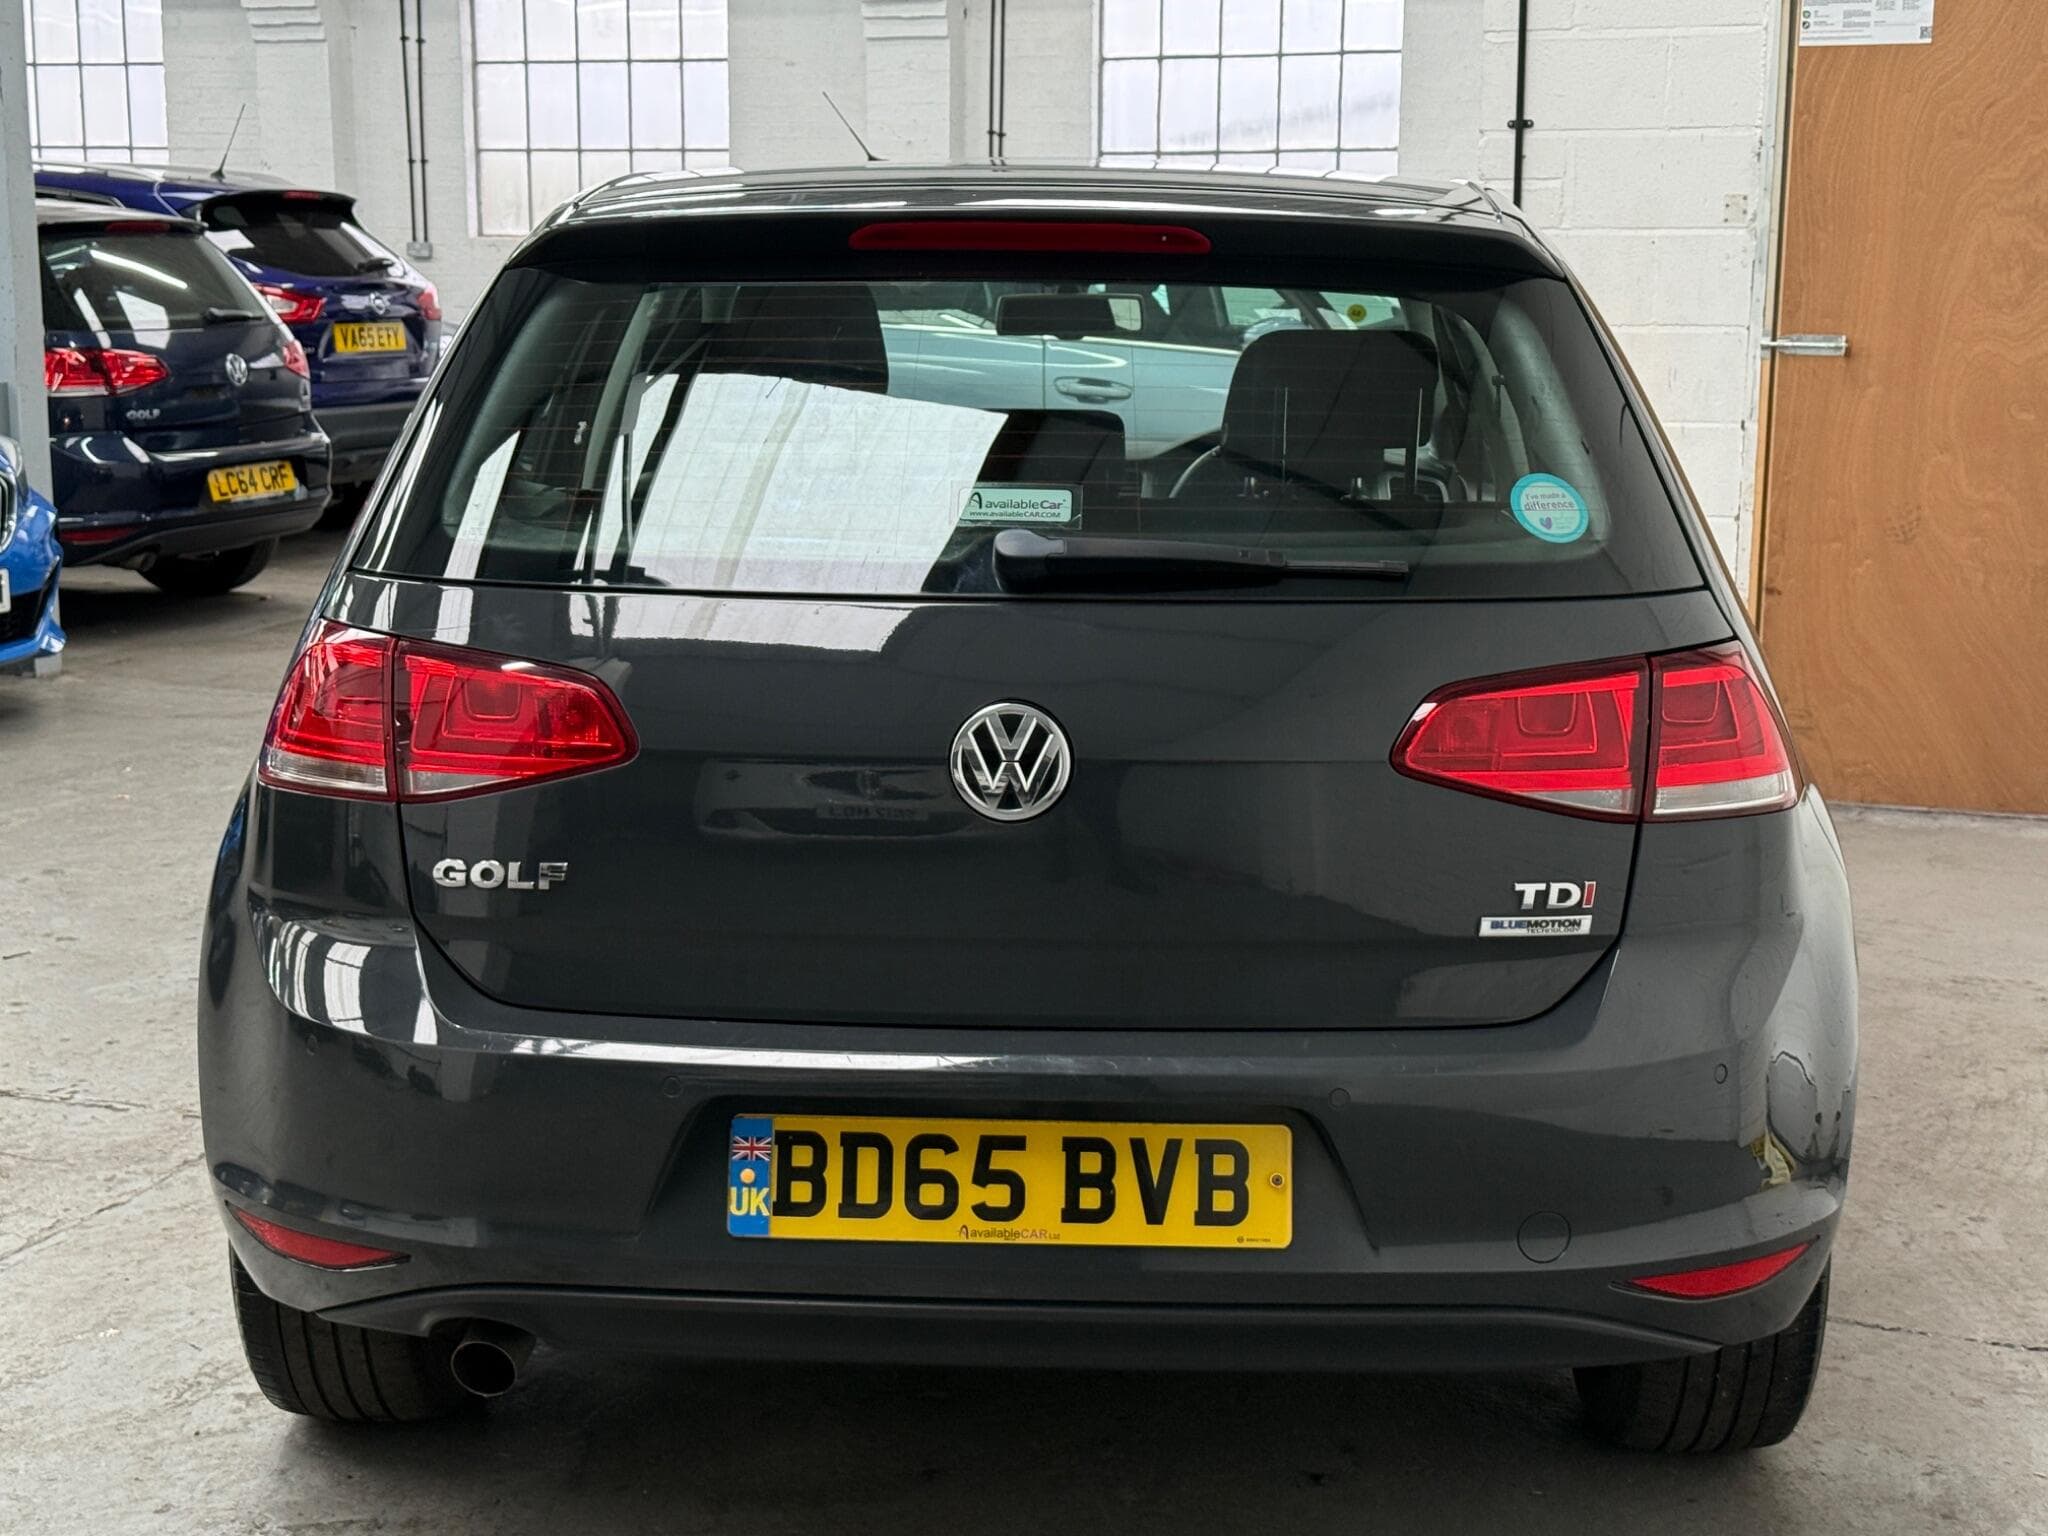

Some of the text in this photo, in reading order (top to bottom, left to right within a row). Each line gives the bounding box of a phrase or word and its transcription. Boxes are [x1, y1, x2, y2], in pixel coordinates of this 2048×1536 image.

[340, 327, 375, 349] VA65
[213, 464, 289, 496] LC64 CRF
[985, 499, 1064, 510] availableCar
[1524, 500, 1576, 511] difference
[432, 858, 569, 890] GOLF
[1514, 881, 1597, 910] TDI
[1490, 919, 1582, 930] BLUEMOTION
[772, 1130, 1251, 1227] BD65 BVB
[729, 1187, 770, 1216] UK
